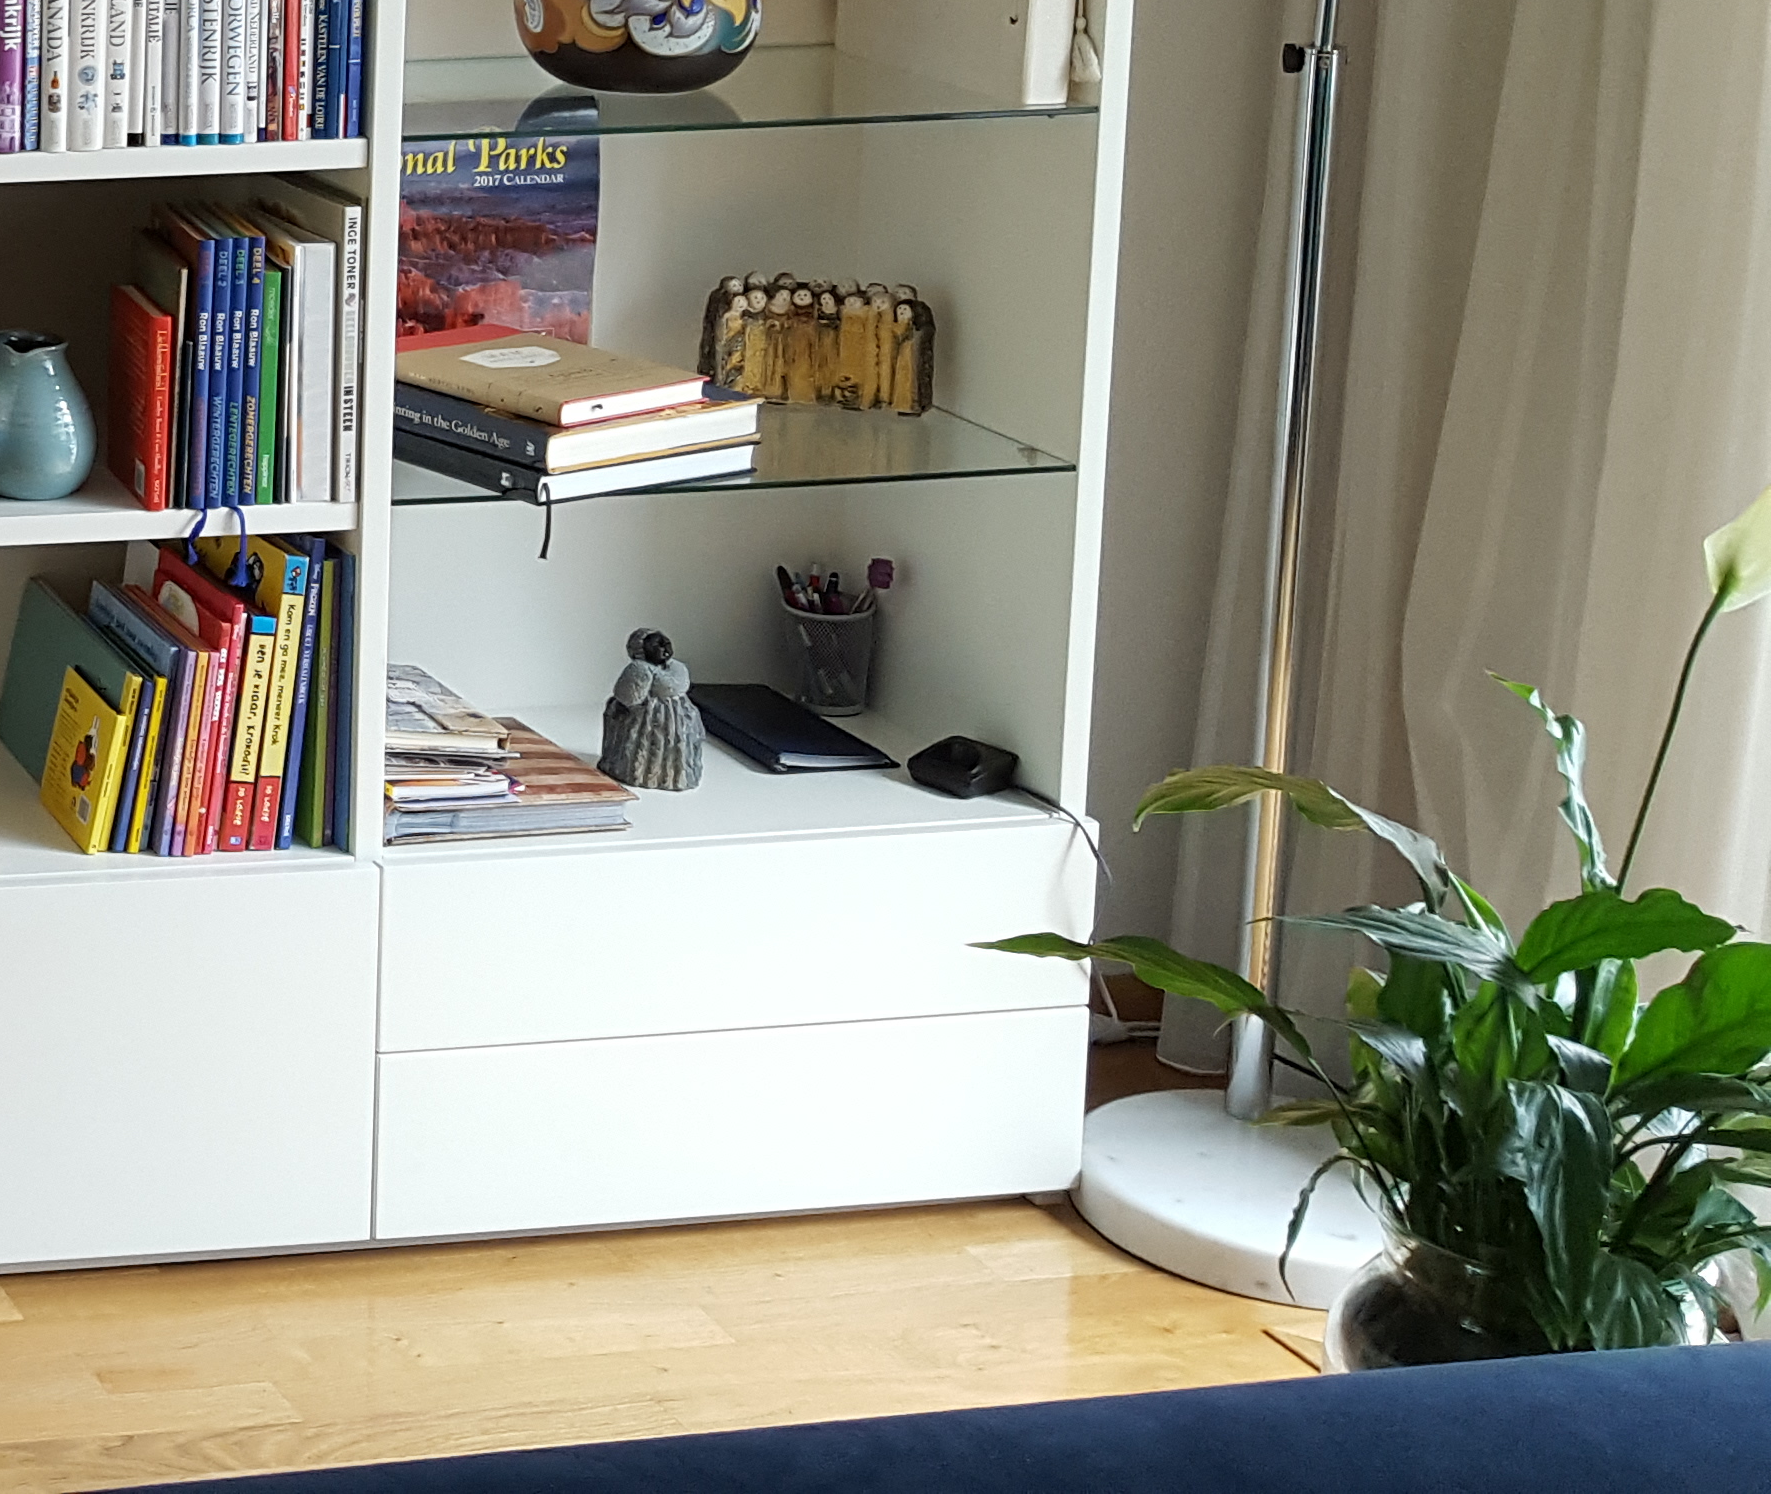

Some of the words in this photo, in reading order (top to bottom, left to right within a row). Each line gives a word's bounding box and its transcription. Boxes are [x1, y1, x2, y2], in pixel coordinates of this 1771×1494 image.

[467, 136, 568, 173] Parks
[474, 175, 499, 188] 2017
[503, 173, 564, 186] CALENDAR
[347, 217, 358, 246] INGE
[346, 250, 357, 290] TONER
[198, 312, 208, 331] Ron
